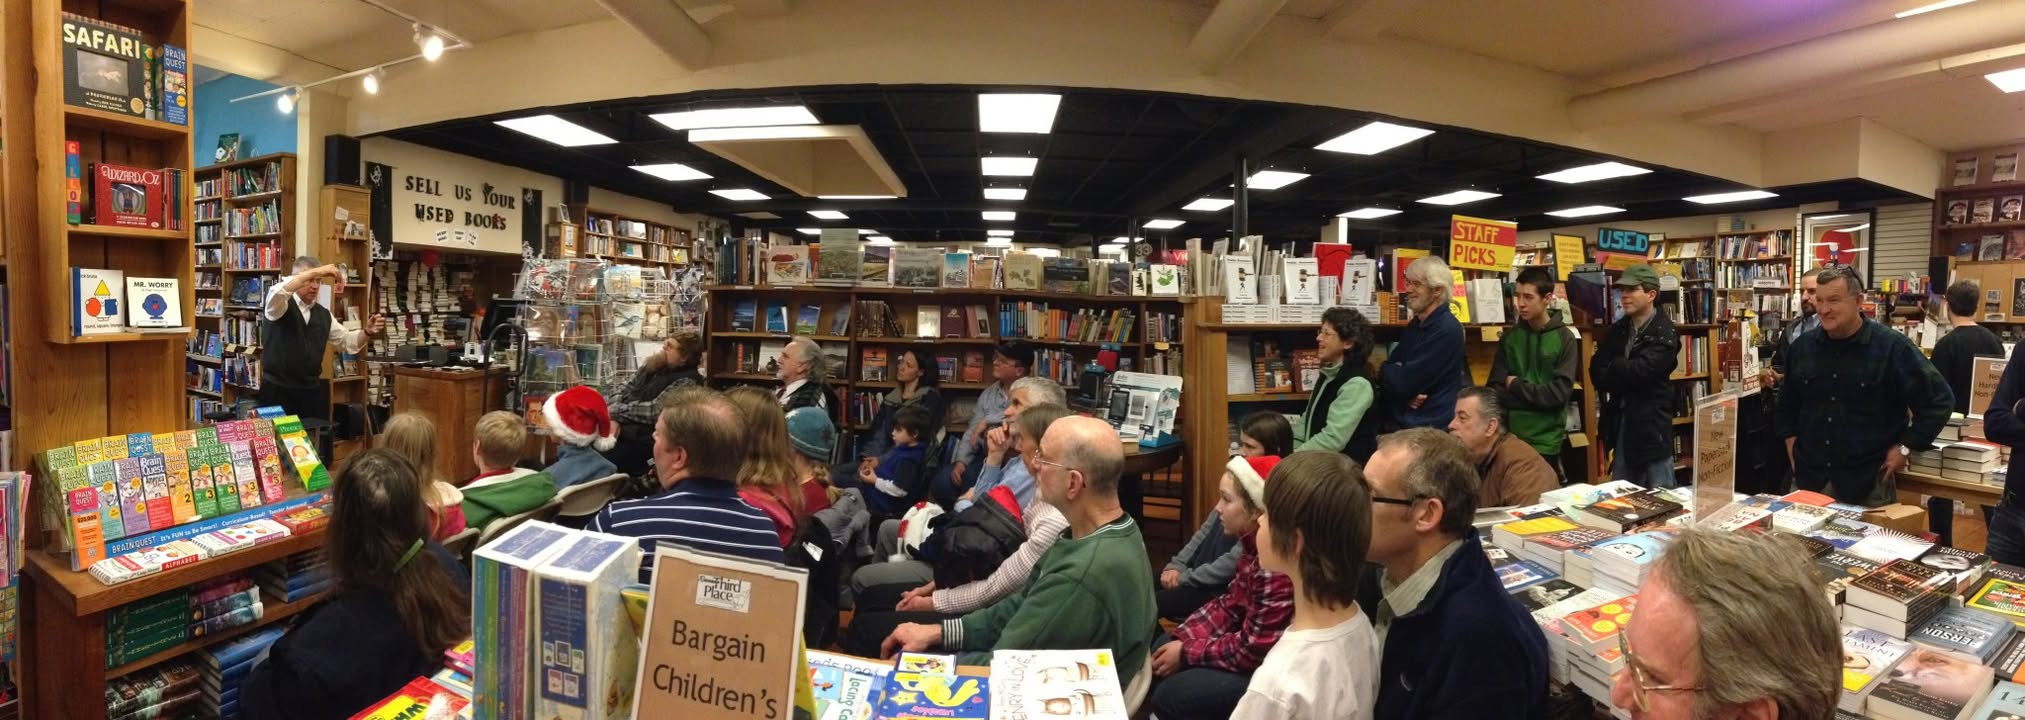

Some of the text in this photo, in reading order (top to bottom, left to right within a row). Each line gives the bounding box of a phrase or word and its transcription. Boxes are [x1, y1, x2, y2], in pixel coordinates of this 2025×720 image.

[63, 23, 141, 59] SAFARI
[165, 48, 186, 60] BRAIN
[165, 58, 186, 70] QUEST
[405, 175, 516, 210] SELL US YOUR
[414, 203, 507, 231] USED BOOKS
[1454, 222, 1500, 243] STAFF
[1599, 229, 1649, 252] USED
[1454, 244, 1496, 266] PICKS
[148, 281, 173, 289] WORRY
[141, 454, 163, 467] Brain
[142, 463, 165, 477] Quest
[229, 485, 236, 494] 3
[250, 481, 256, 490] 3
[184, 494, 191, 503] 2
[207, 490, 214, 499] 3
[112, 541, 134, 554] BRAIN
[134, 536, 156, 549] QUEST
[171, 530, 184, 540] FUN
[165, 555, 198, 570] ALPHABET
[1826, 553, 1880, 572] SWERVE
[704, 584, 734, 601] Place
[714, 577, 742, 593] Third
[671, 619, 766, 664] Bargain
[653, 663, 777, 720] Children's
